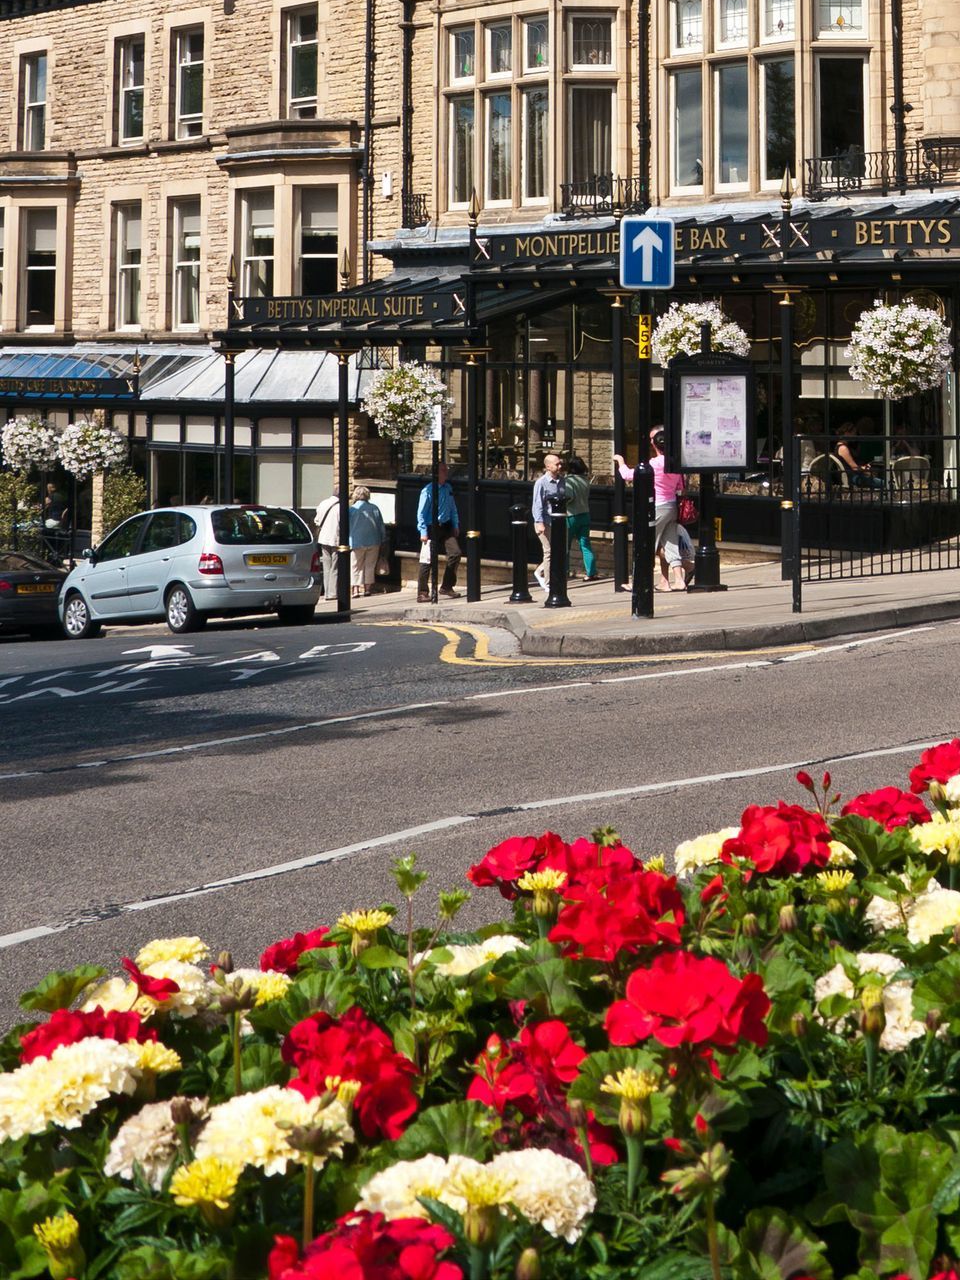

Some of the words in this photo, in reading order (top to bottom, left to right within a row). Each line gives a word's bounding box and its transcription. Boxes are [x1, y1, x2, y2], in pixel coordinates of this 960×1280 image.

[516, 228, 620, 257] MONTPELLIE
[690, 227, 728, 250] BAR
[855, 219, 951, 246] BETTYS
[267, 299, 313, 319] BETTYS
[317, 297, 379, 318] IMPERIAL
[383, 295, 424, 316] SUITE
[640, 316, 650, 357] 454
